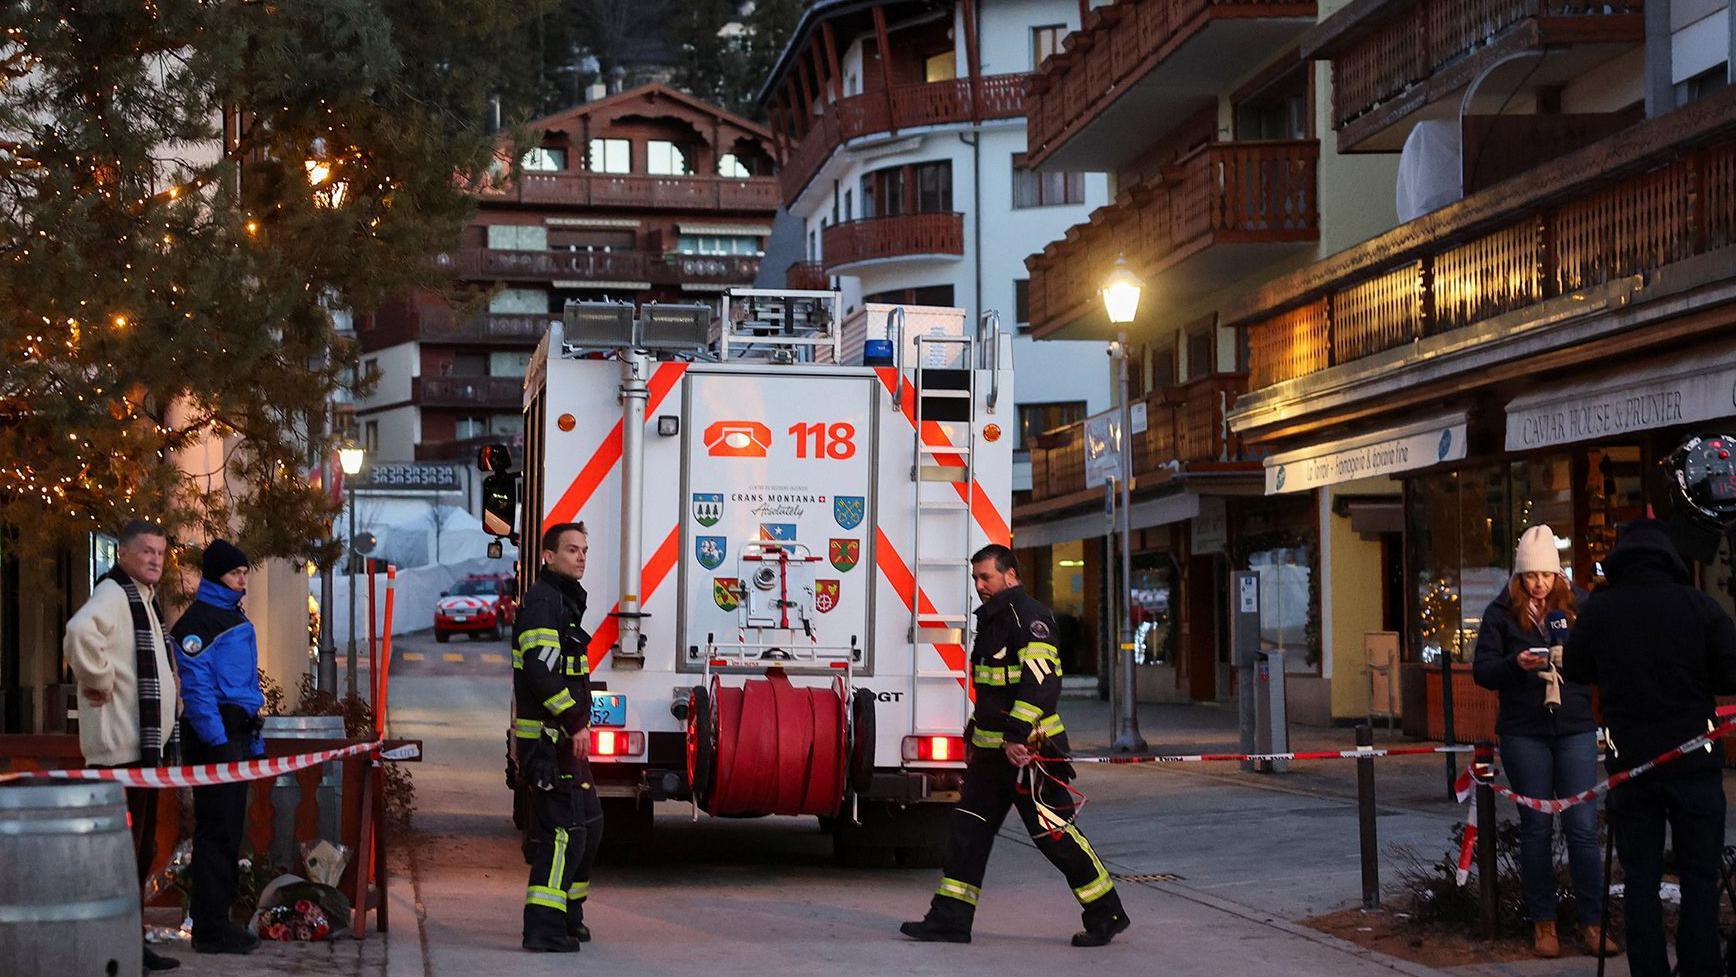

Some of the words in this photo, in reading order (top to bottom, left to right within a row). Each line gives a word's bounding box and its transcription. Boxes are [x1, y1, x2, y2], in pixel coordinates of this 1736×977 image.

[1523, 413, 1566, 445] CAVIAR
[1570, 404, 1611, 437] HOUSE
[1615, 402, 1624, 428] &
[1625, 391, 1683, 428] PRUNIER
[788, 422, 856, 460] 118
[731, 493, 763, 503] CRANS
[767, 494, 815, 503] MONTANA
